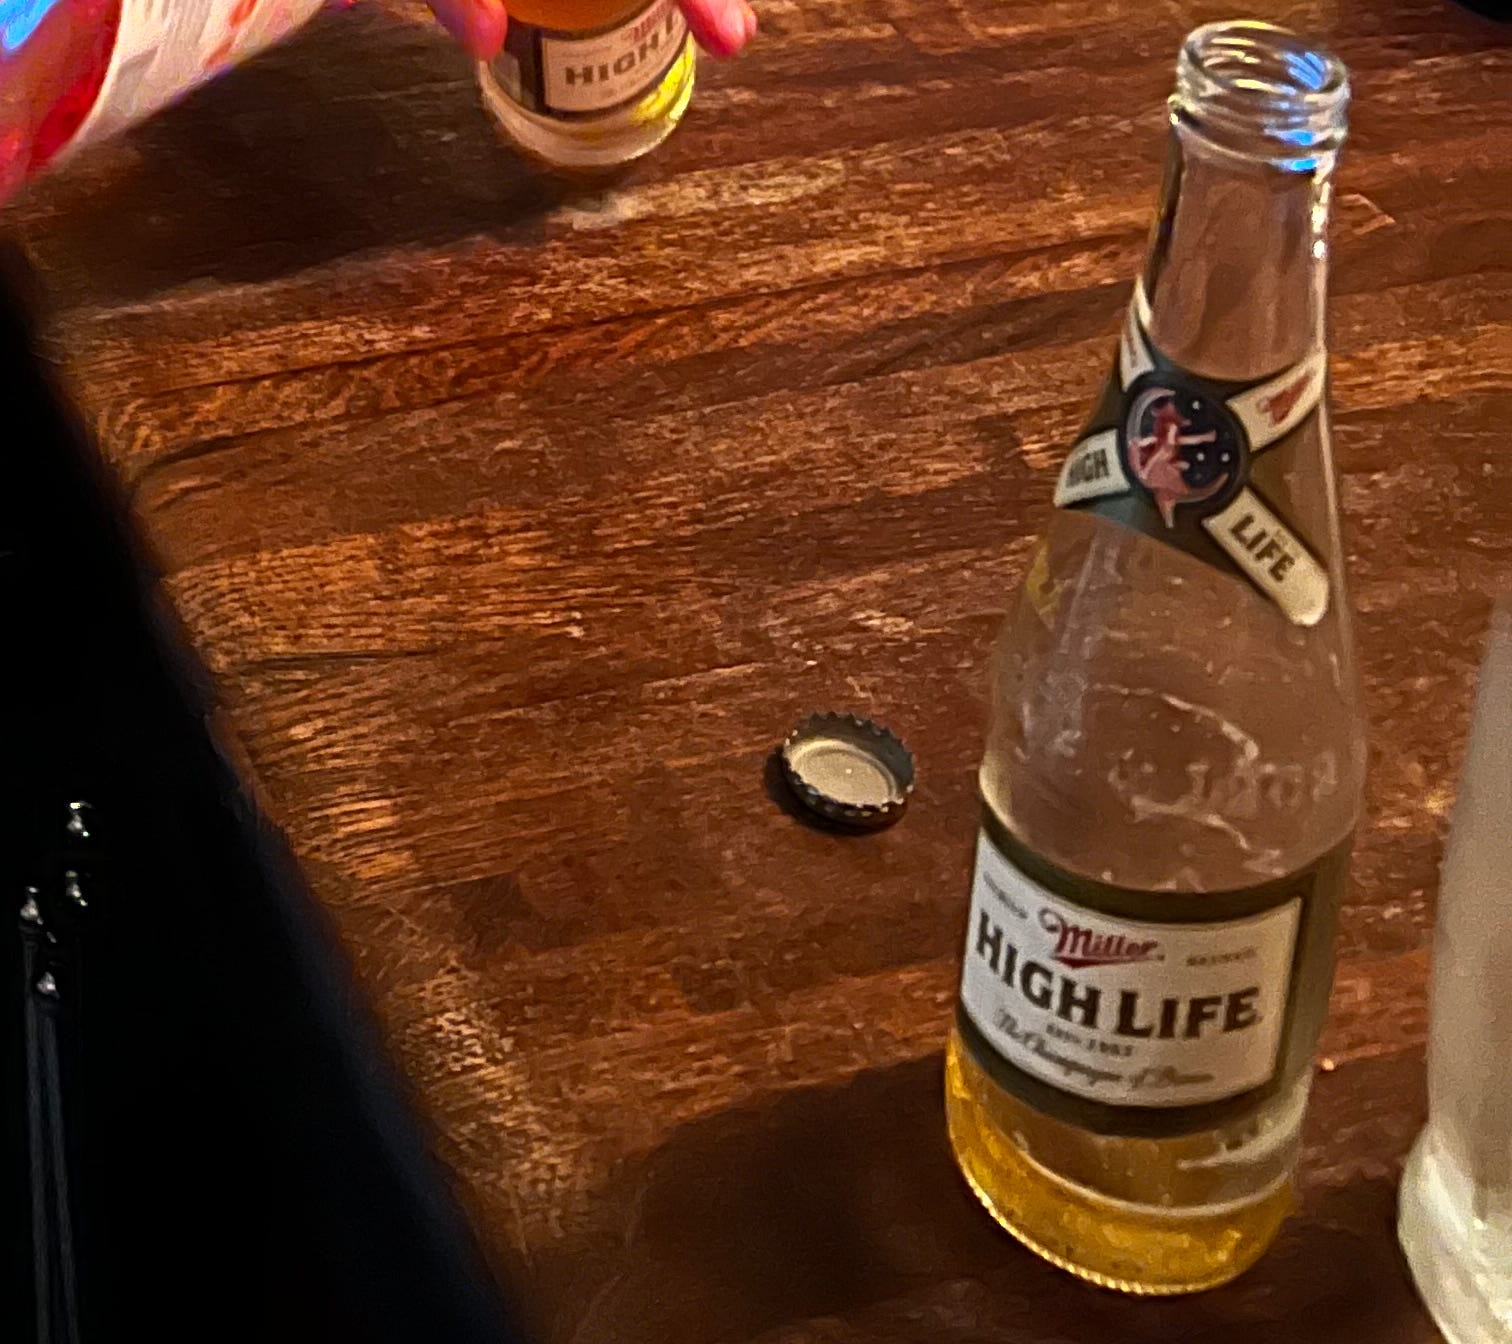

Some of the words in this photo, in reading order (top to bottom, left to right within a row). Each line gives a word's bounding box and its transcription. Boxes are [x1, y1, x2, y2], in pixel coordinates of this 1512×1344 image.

[1230, 514, 1297, 584] LIFE
[976, 908, 1102, 1029] HIGH
[1116, 986, 1261, 1039] LIFE
[1039, 907, 1159, 970] Miller
